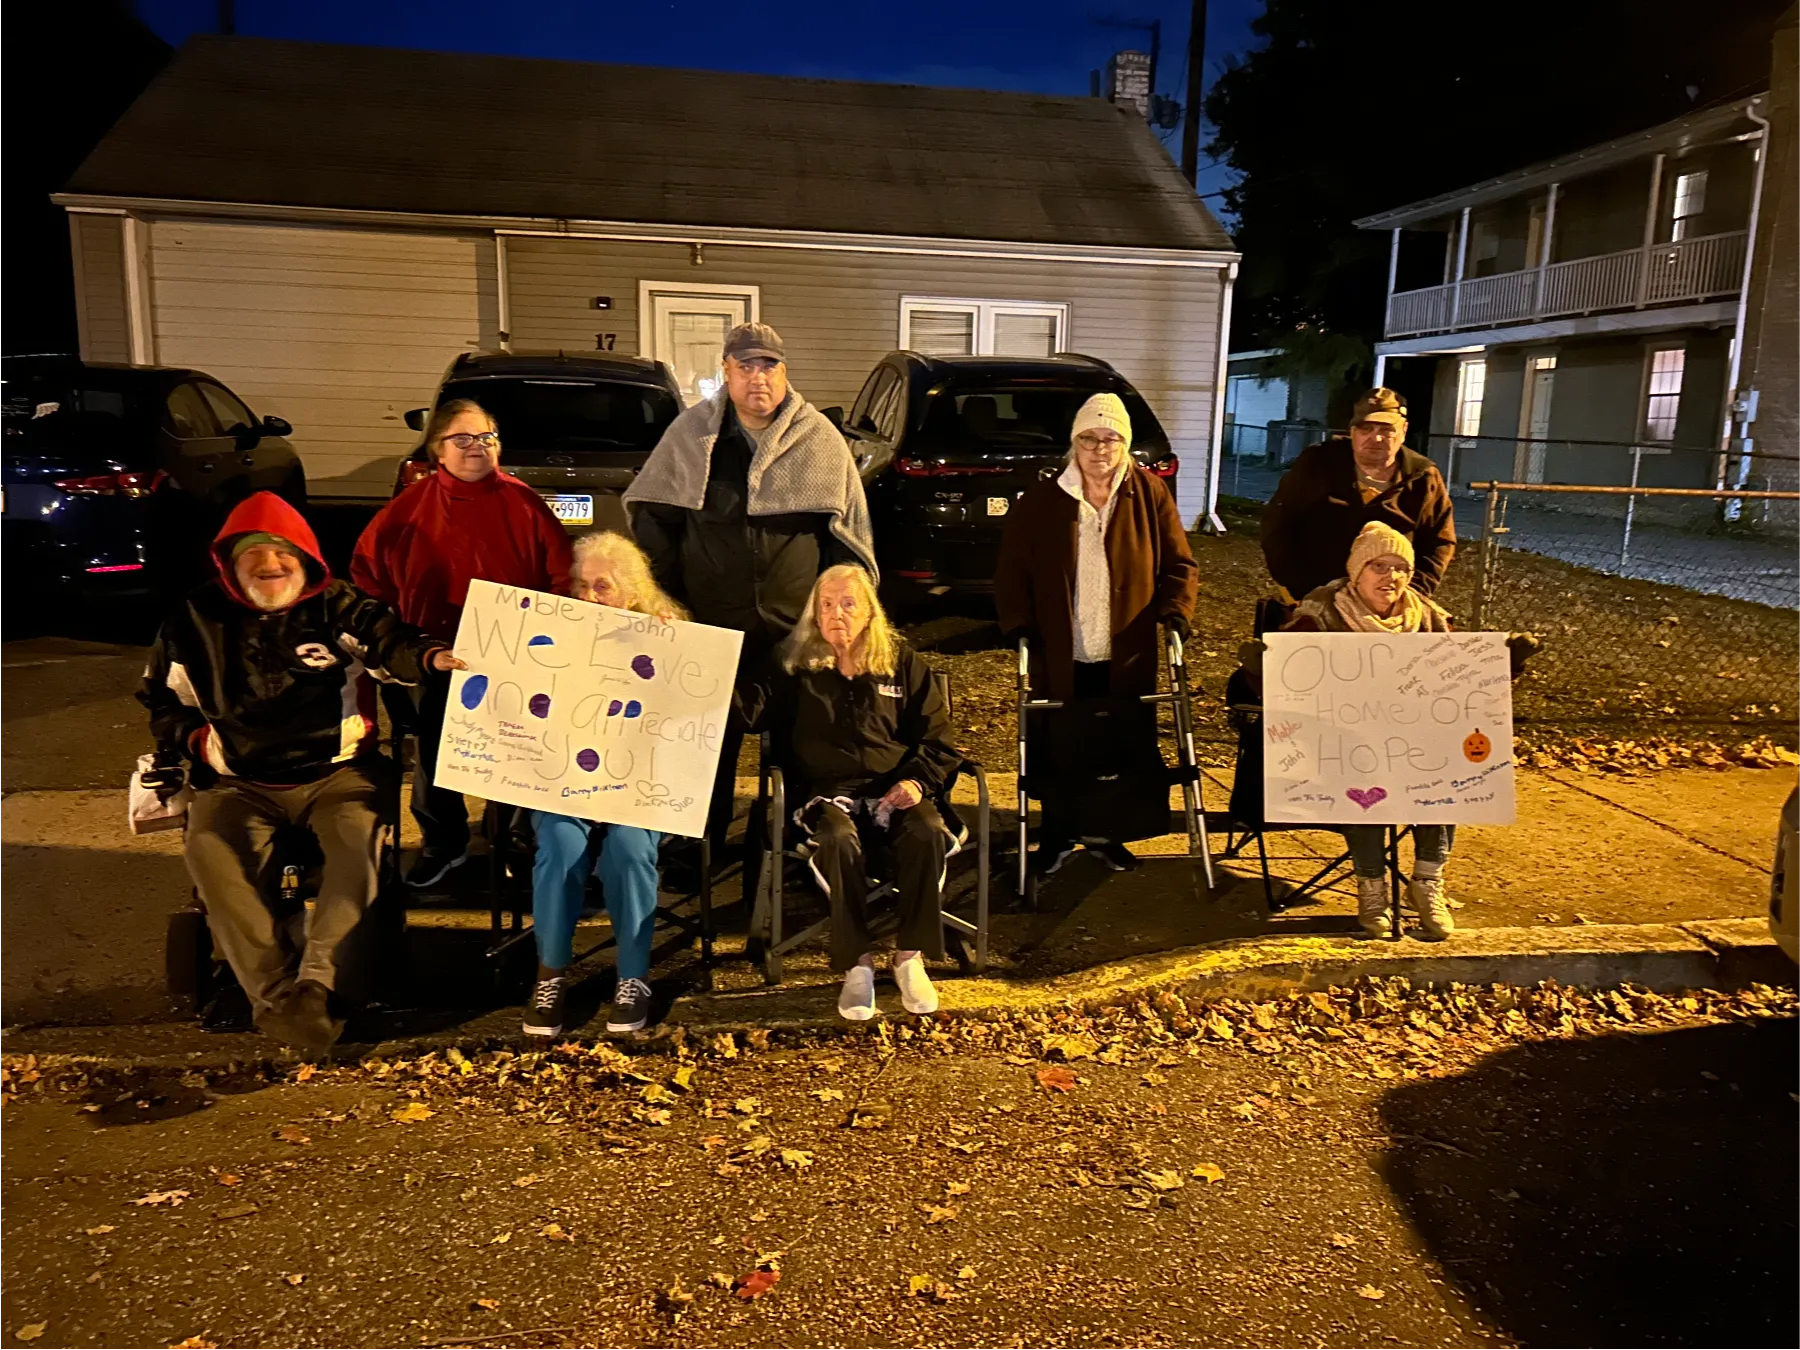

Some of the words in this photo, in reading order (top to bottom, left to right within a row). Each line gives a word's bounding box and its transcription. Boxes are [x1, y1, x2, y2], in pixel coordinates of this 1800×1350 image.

[594, 333, 617, 351] 17
[614, 612, 676, 643] John
[474, 606, 571, 669] We
[588, 622, 719, 698] Love
